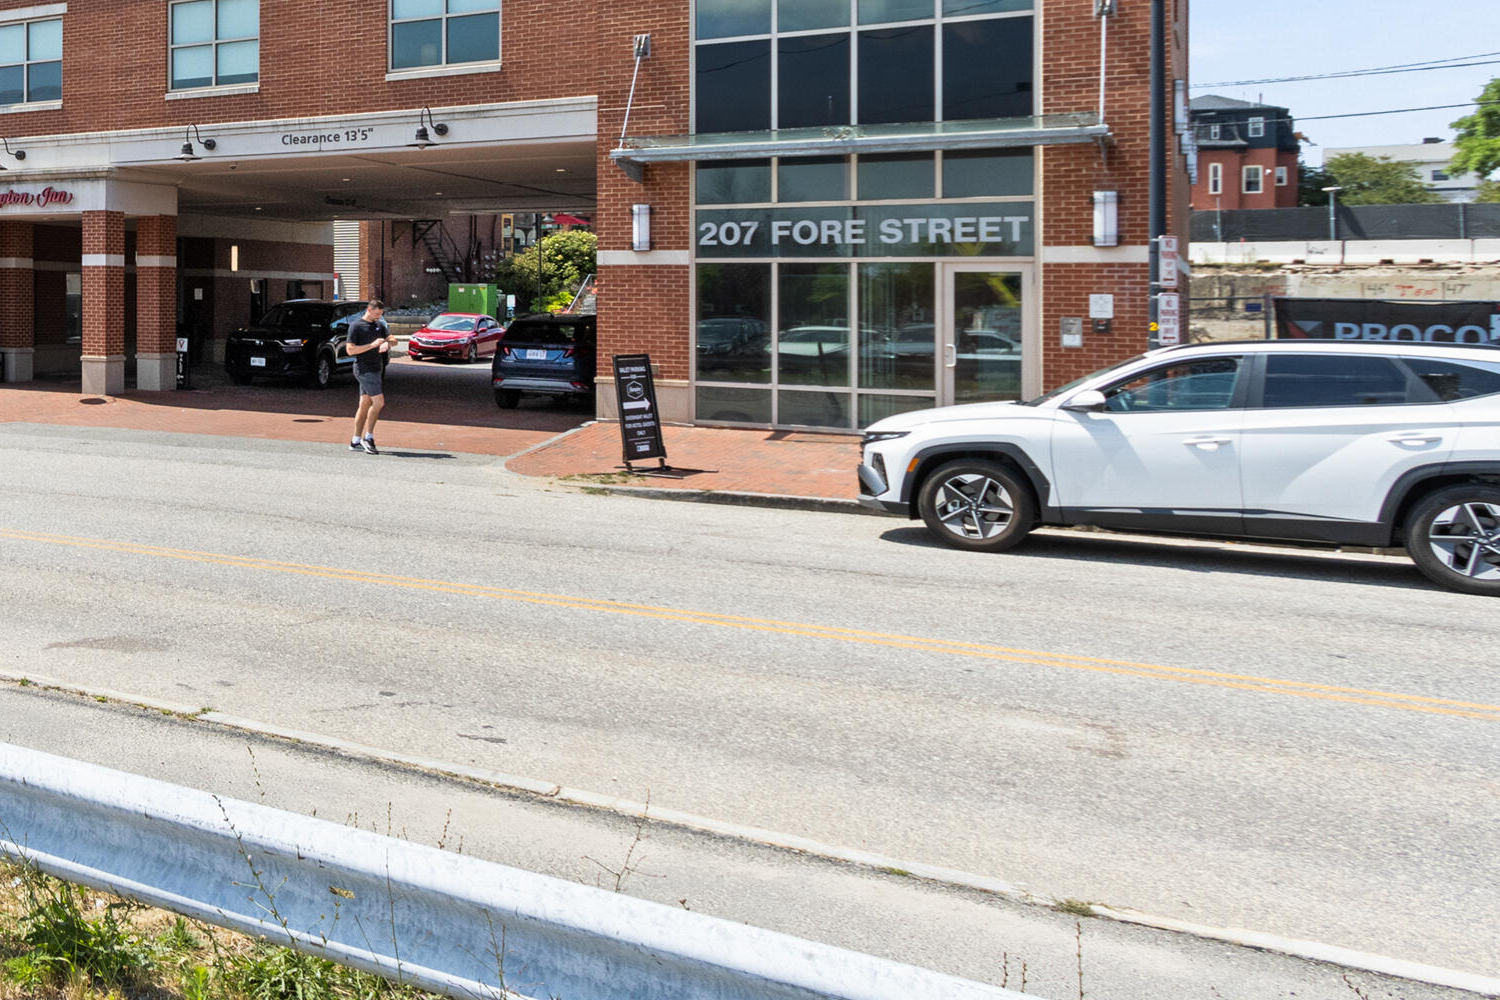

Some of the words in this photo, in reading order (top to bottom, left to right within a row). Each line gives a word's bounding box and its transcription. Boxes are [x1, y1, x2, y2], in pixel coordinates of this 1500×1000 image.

[281, 133, 341, 145] Clearance
[344, 128, 374, 142] 13'5"
[36, 186, 73, 208] Inn
[699, 221, 759, 246] 207
[771, 219, 866, 245] FORE
[879, 216, 1029, 244] STREET
